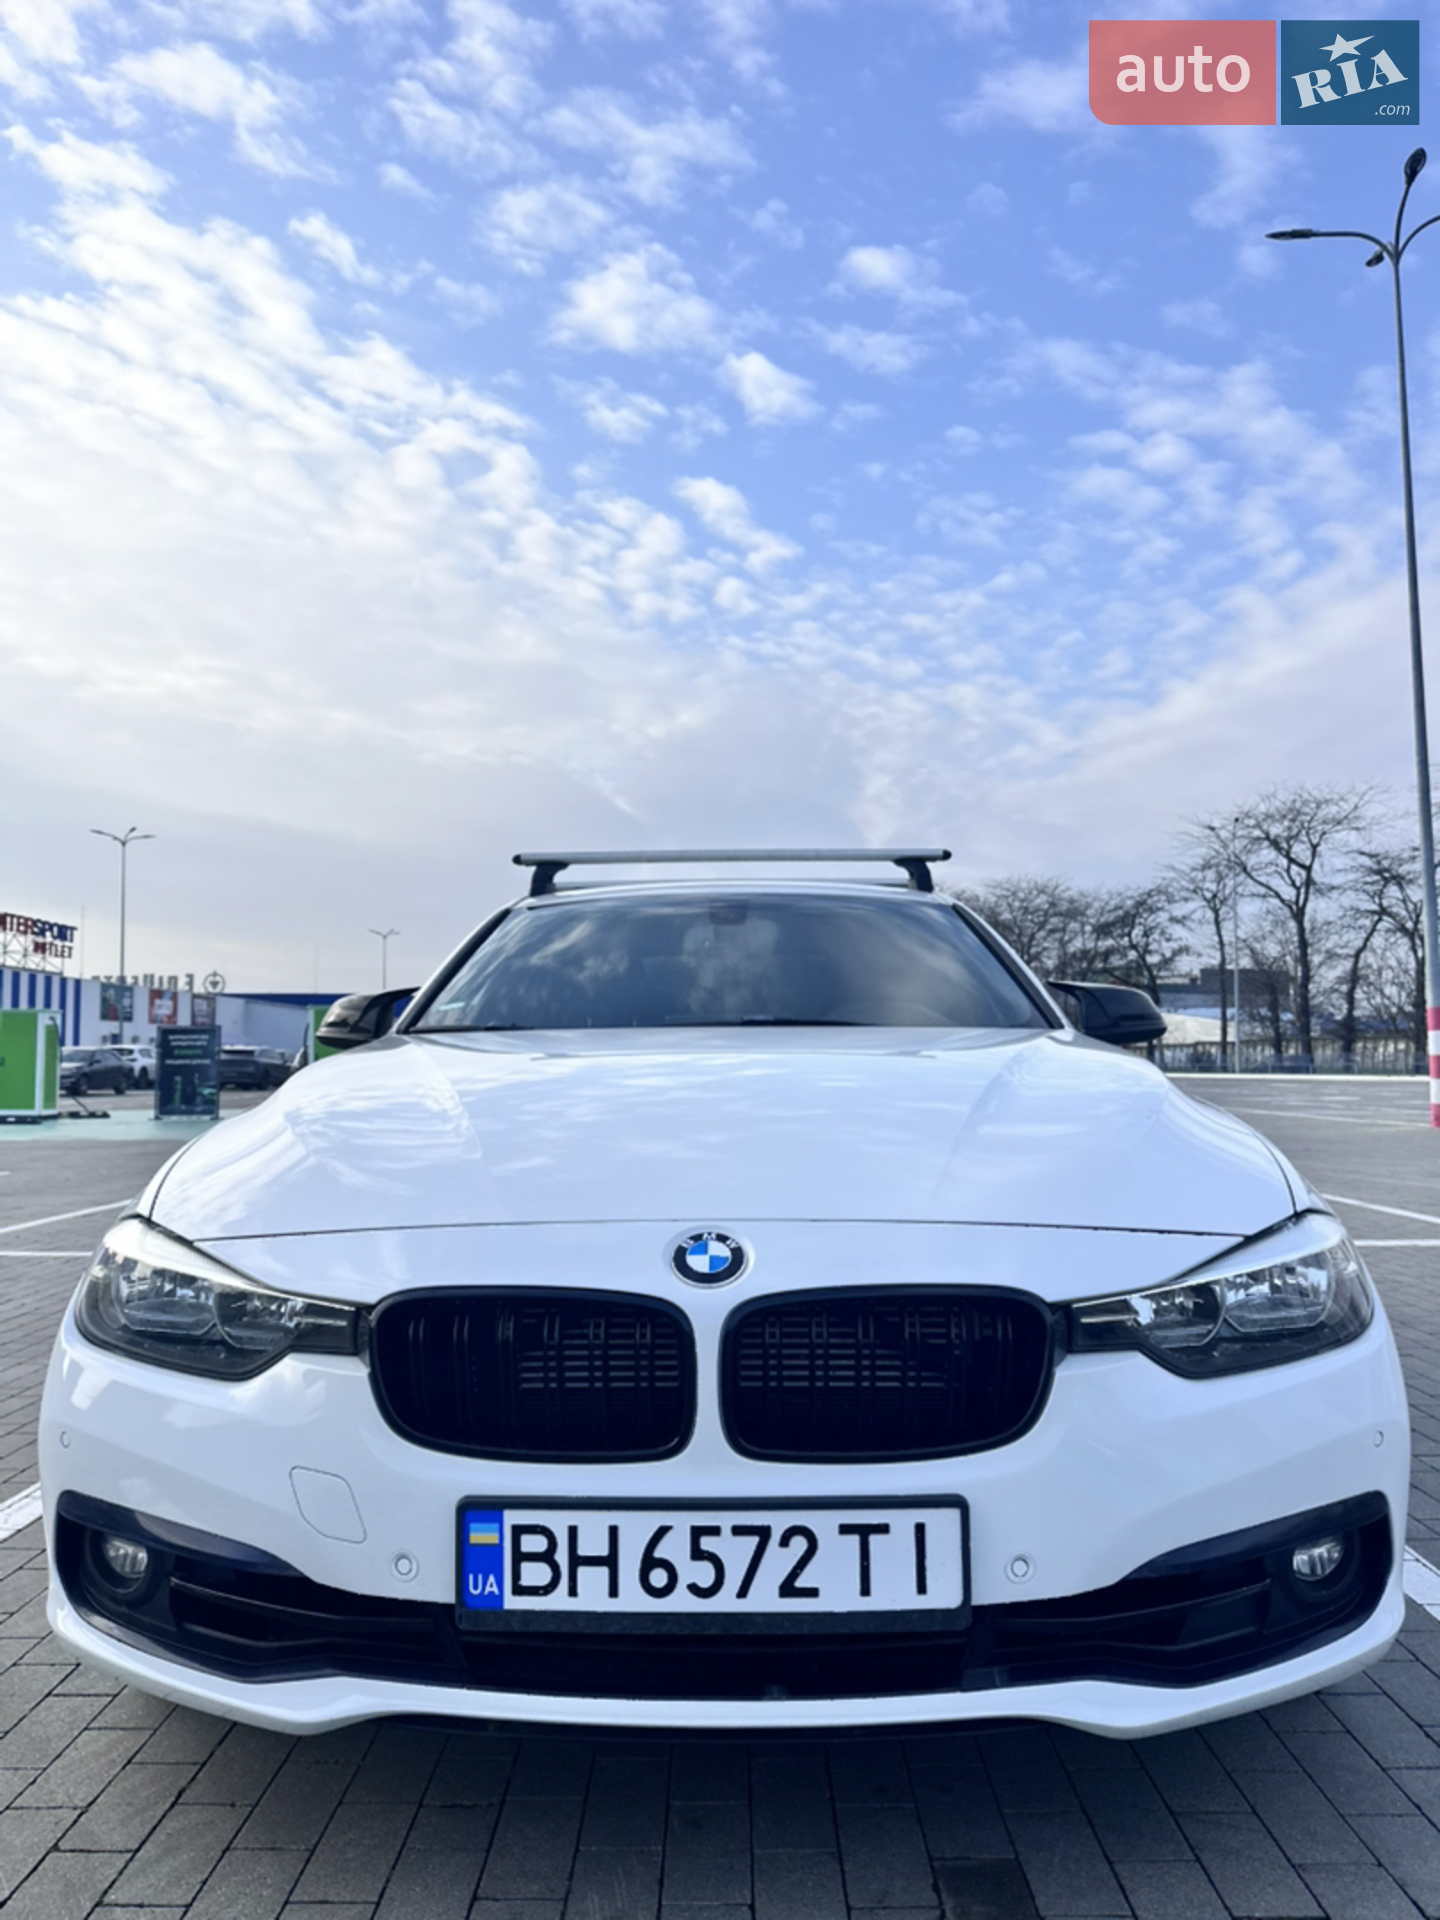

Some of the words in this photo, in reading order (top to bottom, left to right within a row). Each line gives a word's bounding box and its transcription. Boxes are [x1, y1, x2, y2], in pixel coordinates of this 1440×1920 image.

[680, 1232, 741, 1249] BMW
[638, 1523, 821, 1599] 6572
[467, 1573, 499, 1597] UA
